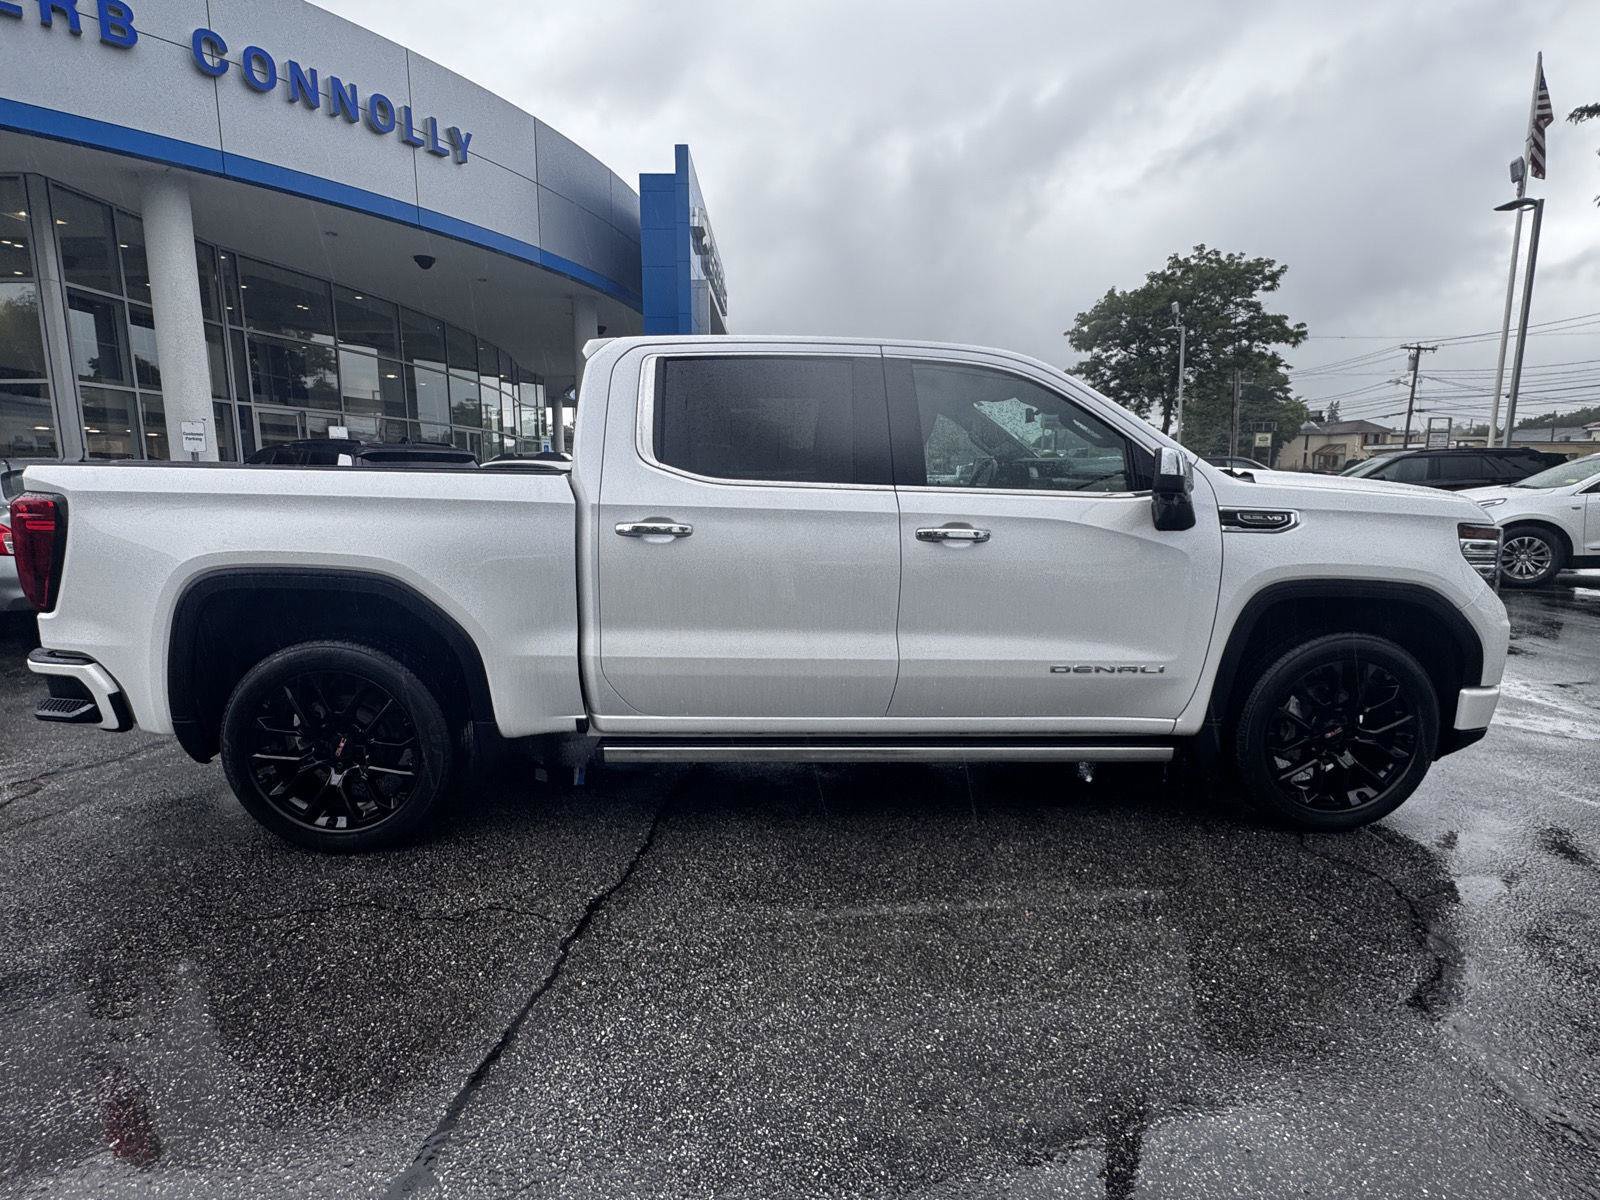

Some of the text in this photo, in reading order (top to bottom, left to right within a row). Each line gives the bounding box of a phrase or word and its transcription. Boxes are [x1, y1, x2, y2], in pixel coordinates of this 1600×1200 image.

[0, 0, 473, 164] RB CONNOLLY
[1049, 665, 1165, 674] DENALI
